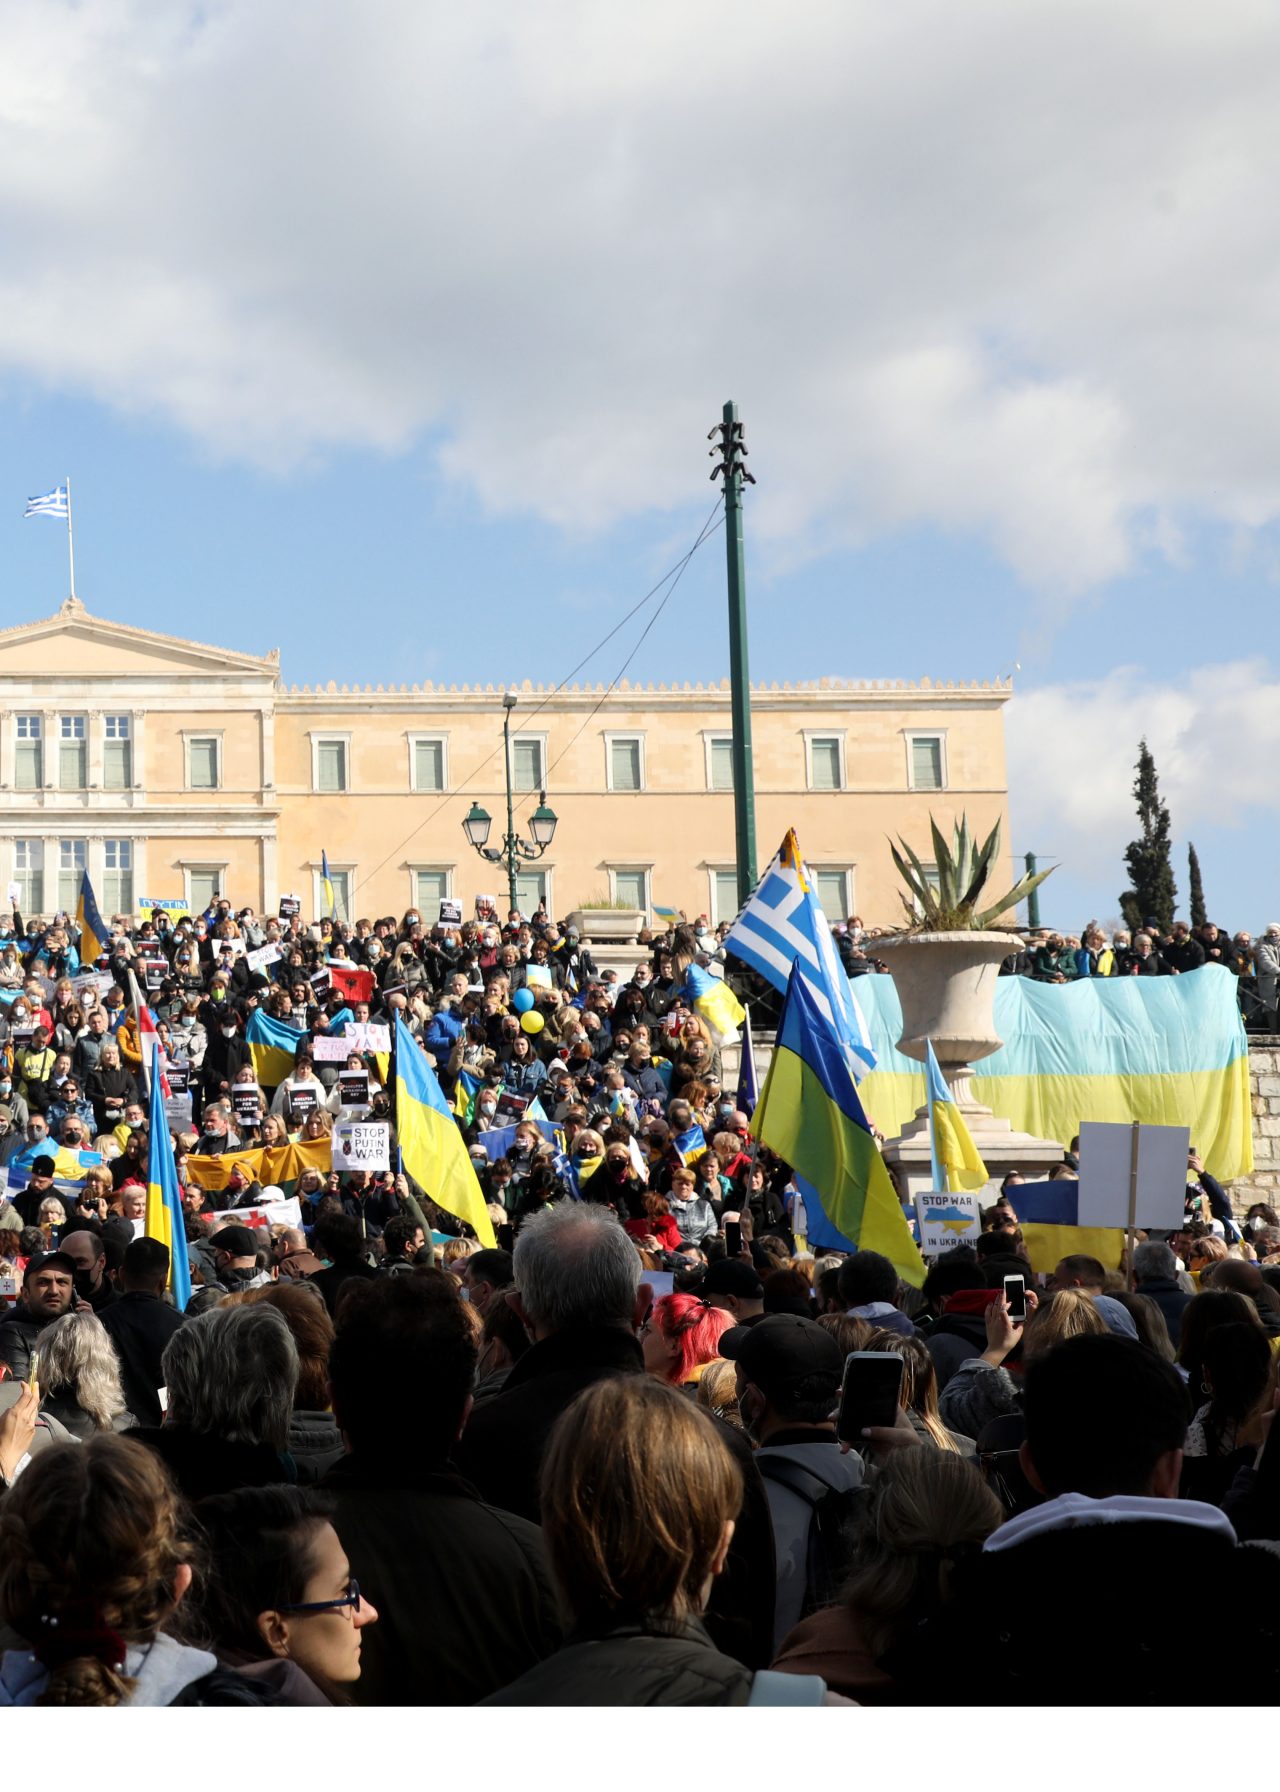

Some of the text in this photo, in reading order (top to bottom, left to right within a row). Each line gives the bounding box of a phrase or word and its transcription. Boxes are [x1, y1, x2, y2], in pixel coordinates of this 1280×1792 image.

[354, 1128, 385, 1138] STOP
[355, 1139, 384, 1147] PUTIN
[355, 1149, 384, 1159] WAR
[922, 1196, 972, 1206] STOP WAR
[928, 1238, 978, 1247] IN UKRAINE
